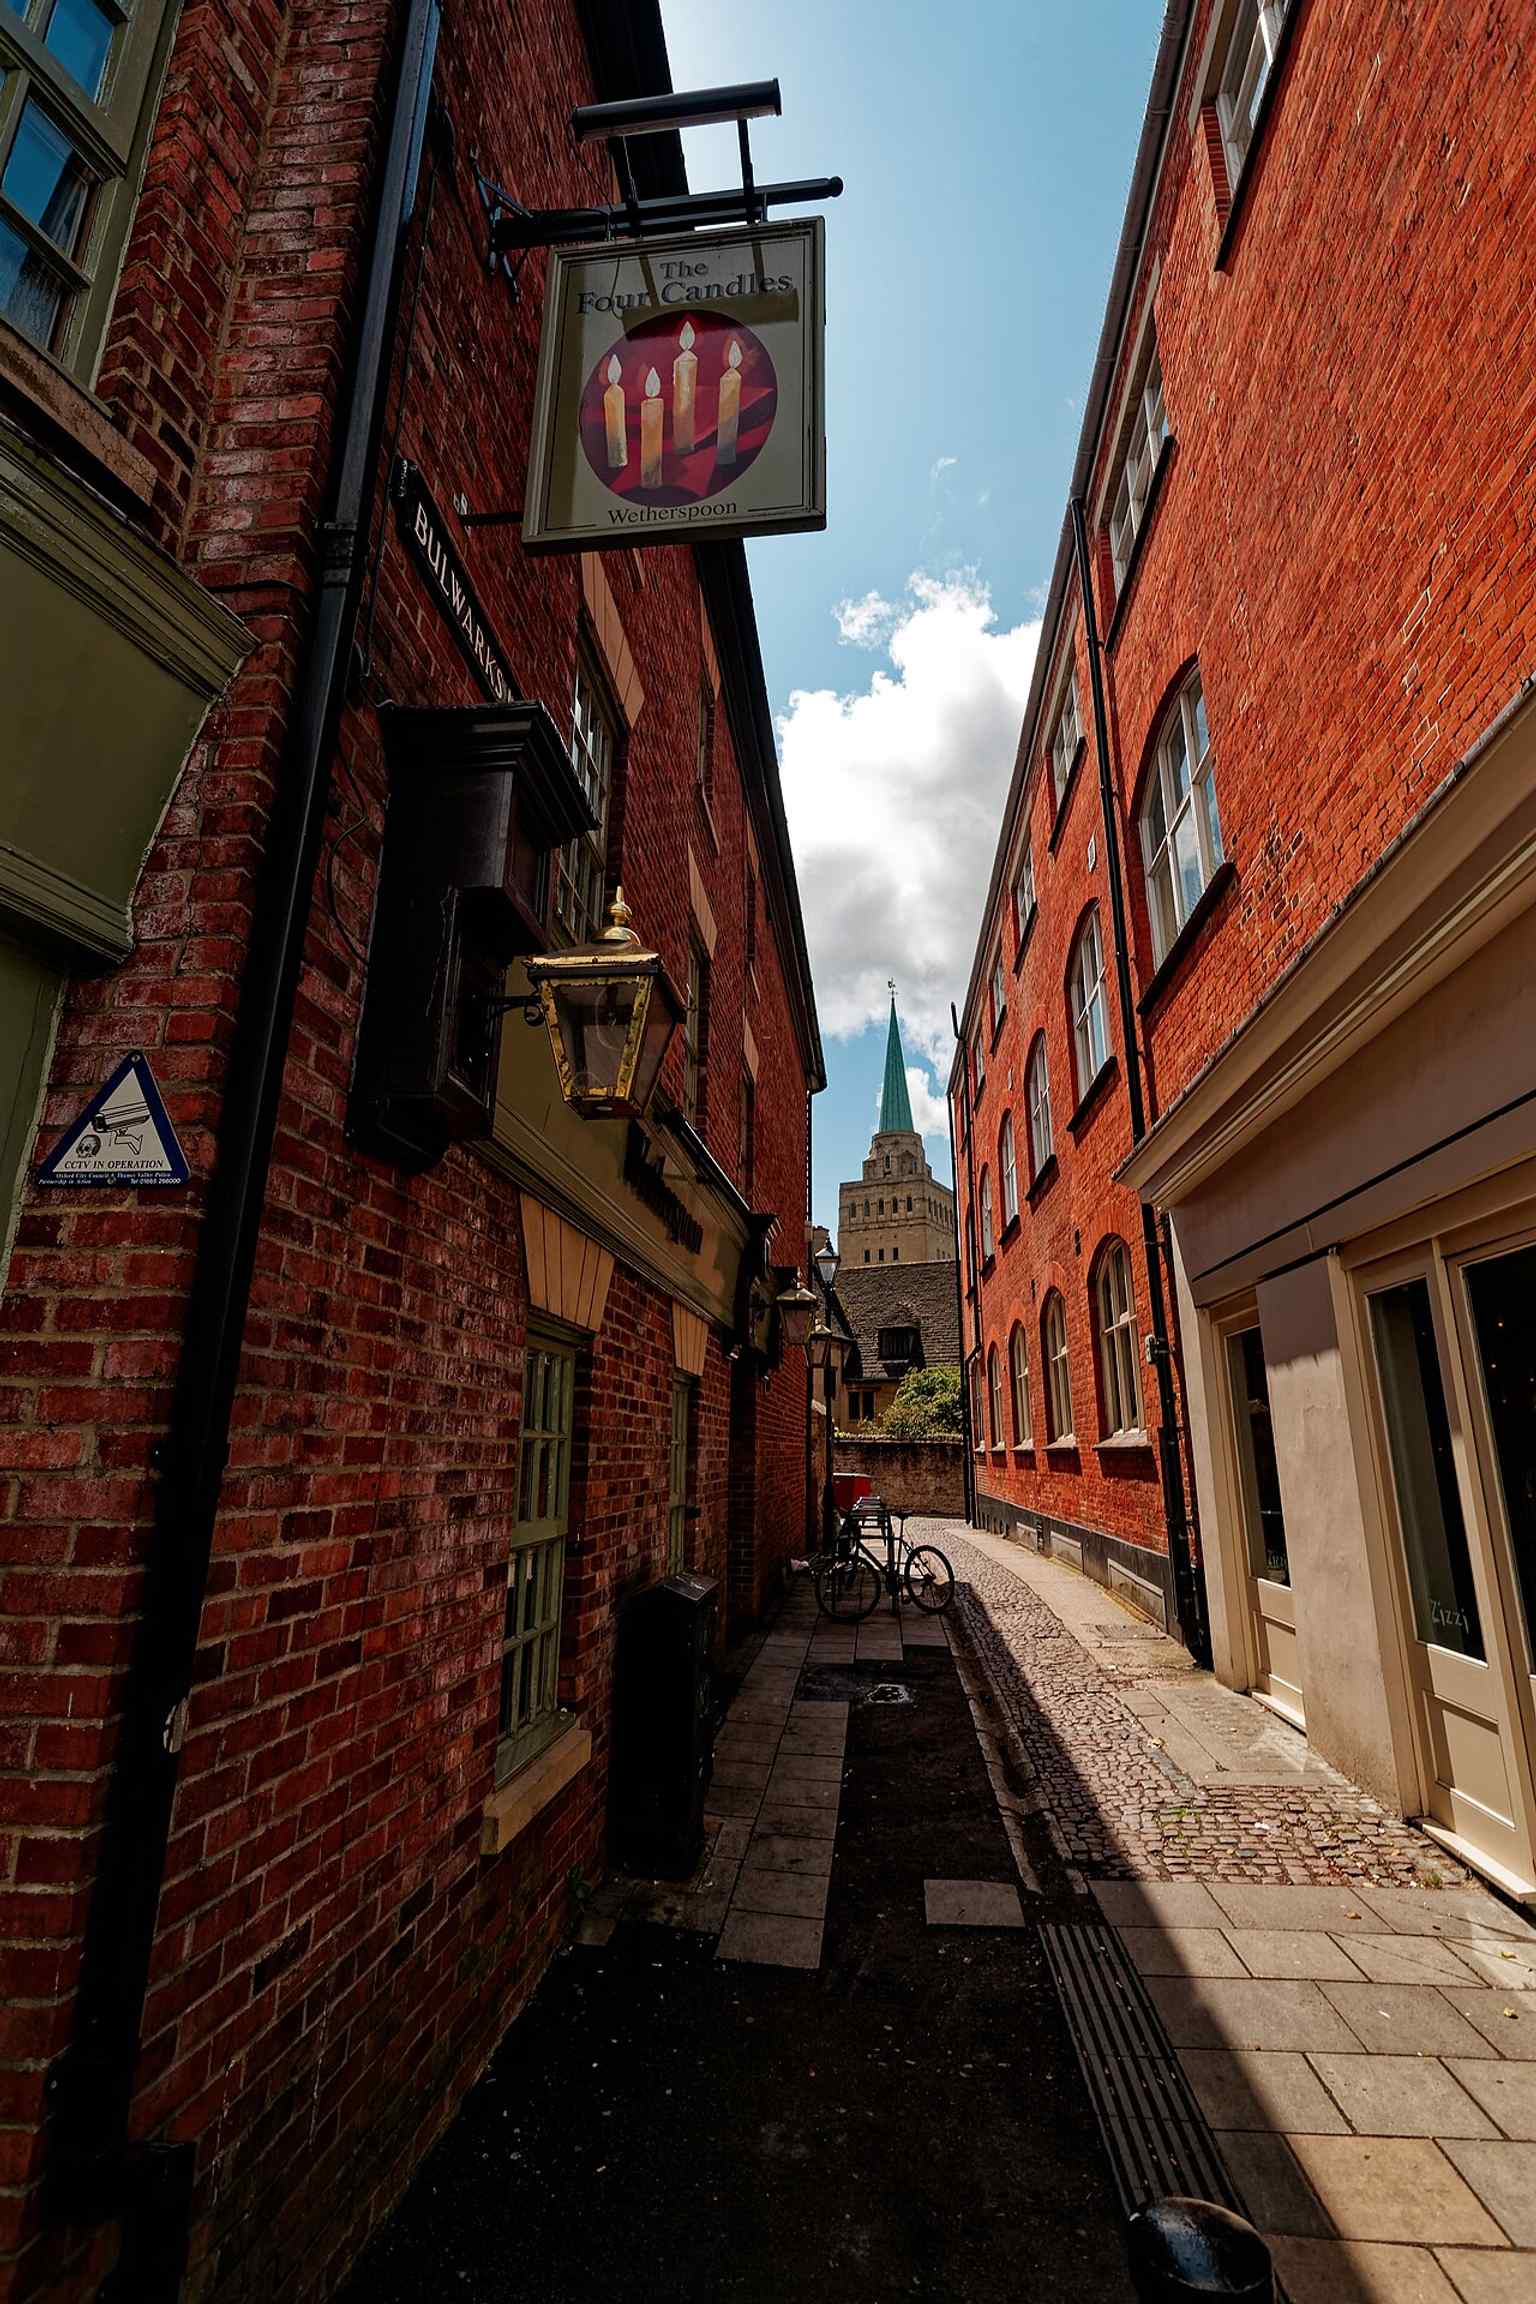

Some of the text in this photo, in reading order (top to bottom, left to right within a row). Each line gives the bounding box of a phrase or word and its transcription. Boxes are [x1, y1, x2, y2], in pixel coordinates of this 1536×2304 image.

[660, 261, 708, 279] The
[576, 271, 793, 314] Four Candles
[608, 501, 737, 525] Wetherspoon
[414, 501, 504, 700] BULWARKS
[64, 1159, 164, 1169] CCTV IN OPERATION
[1431, 1599, 1469, 1634] Zizzi
